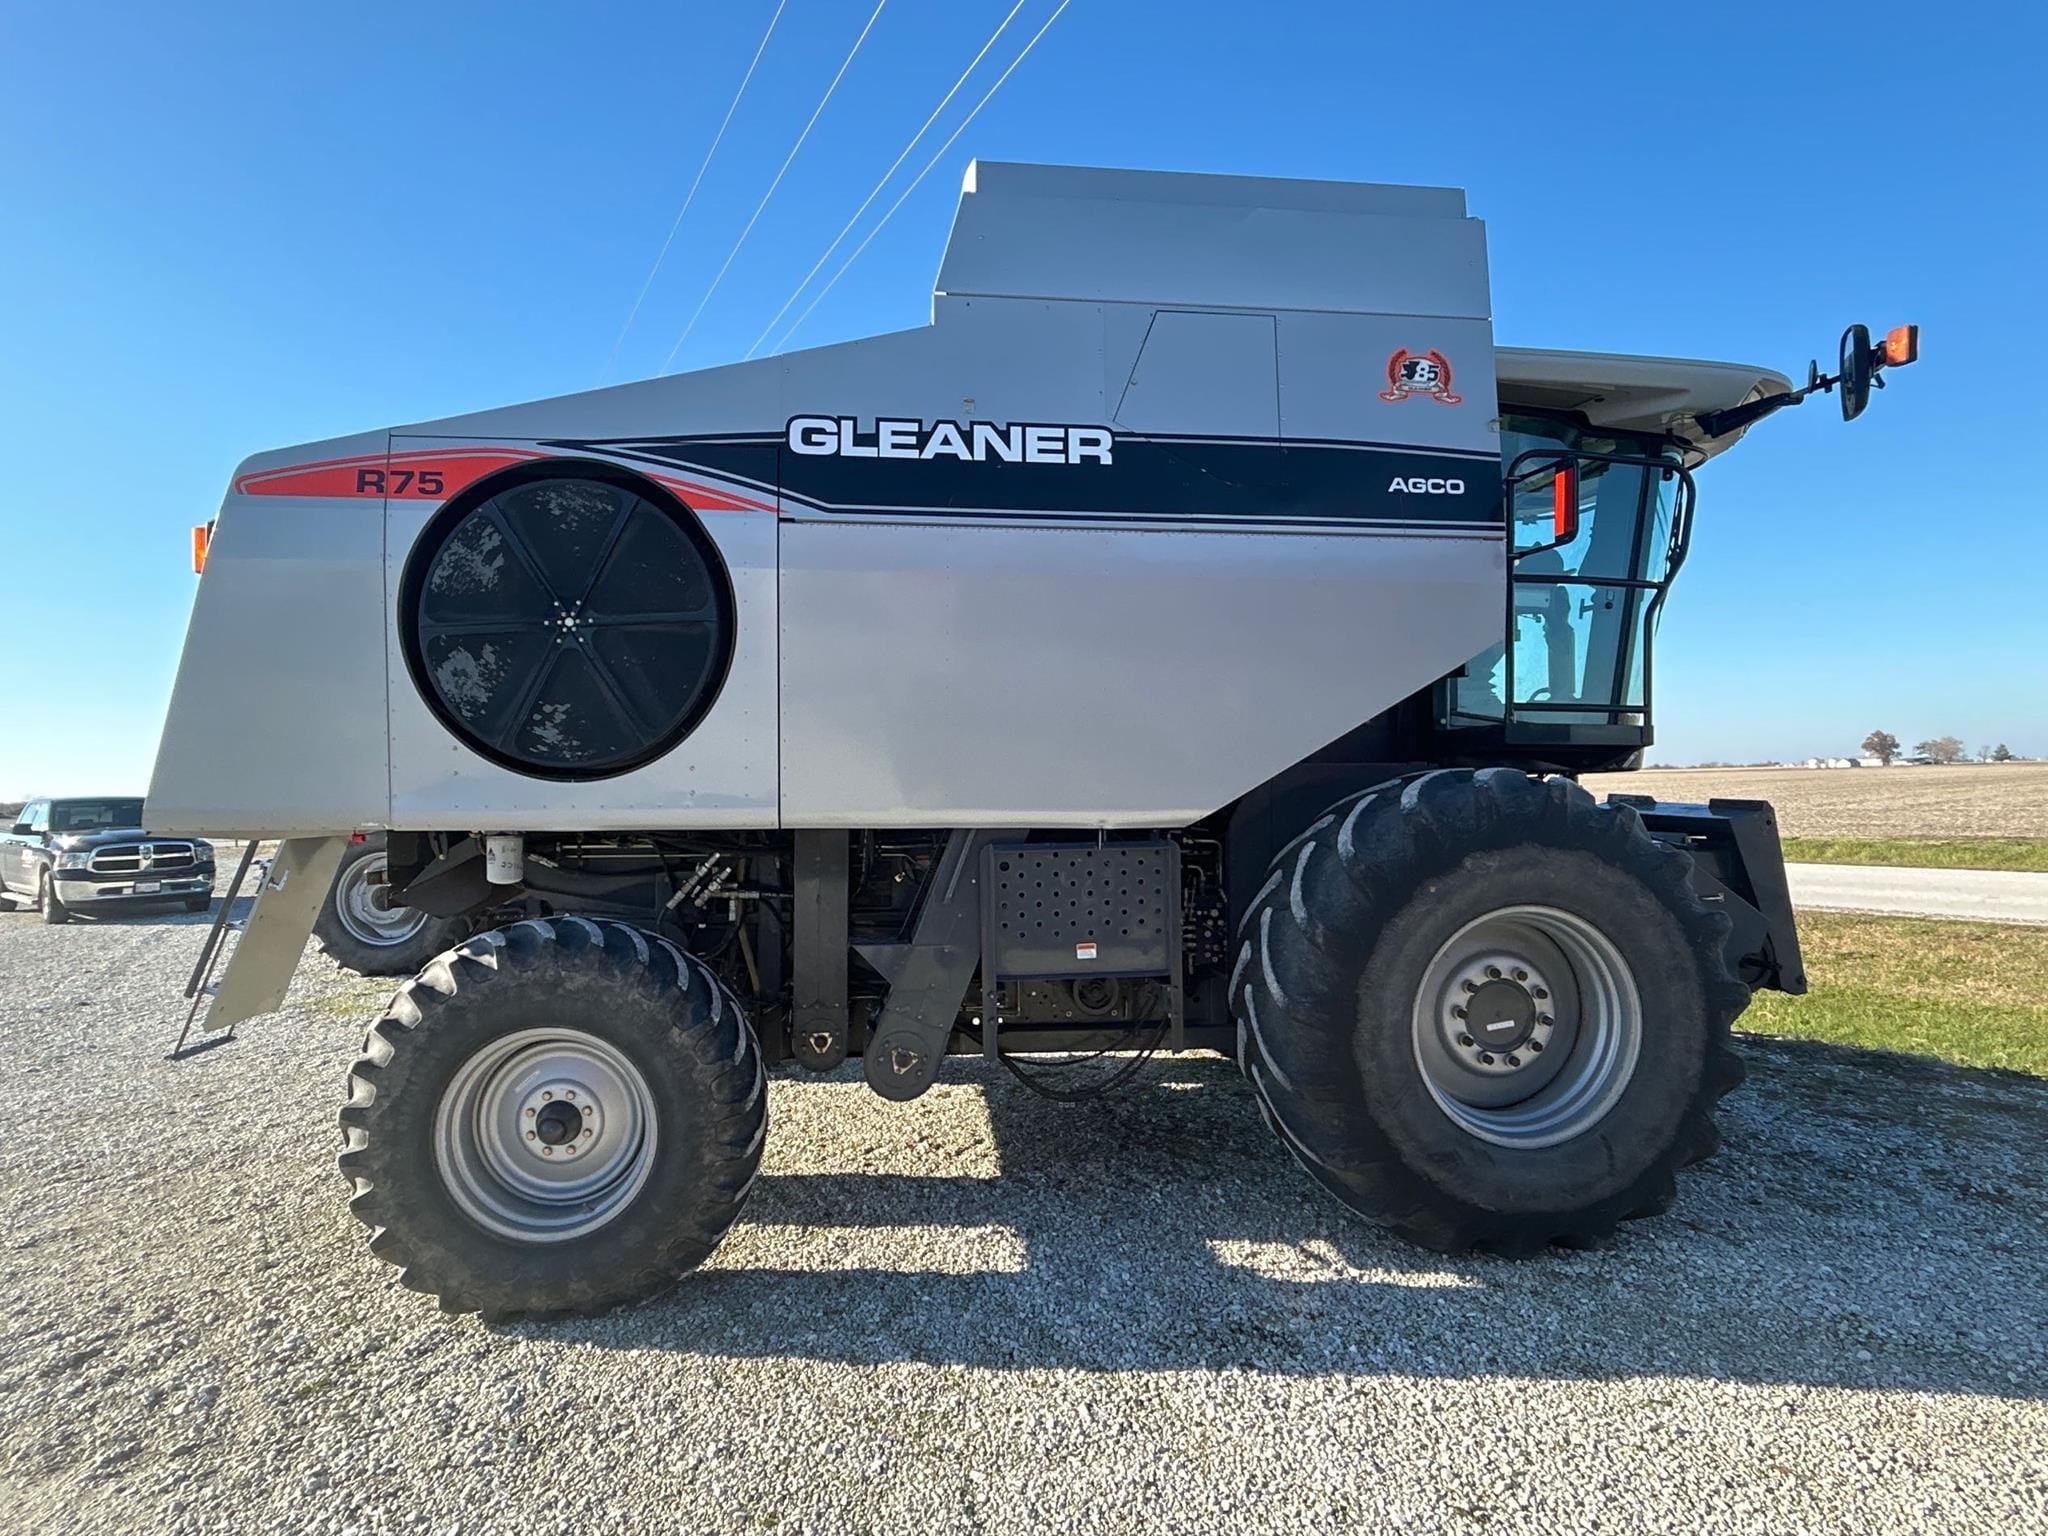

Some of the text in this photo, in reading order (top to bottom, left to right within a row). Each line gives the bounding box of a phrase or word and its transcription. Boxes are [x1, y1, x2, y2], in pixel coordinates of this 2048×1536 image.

[1416, 361, 1440, 382] 85
[789, 418, 1113, 465] GLEANER
[356, 469, 444, 495] R75
[1388, 477, 1465, 494] AGCO
